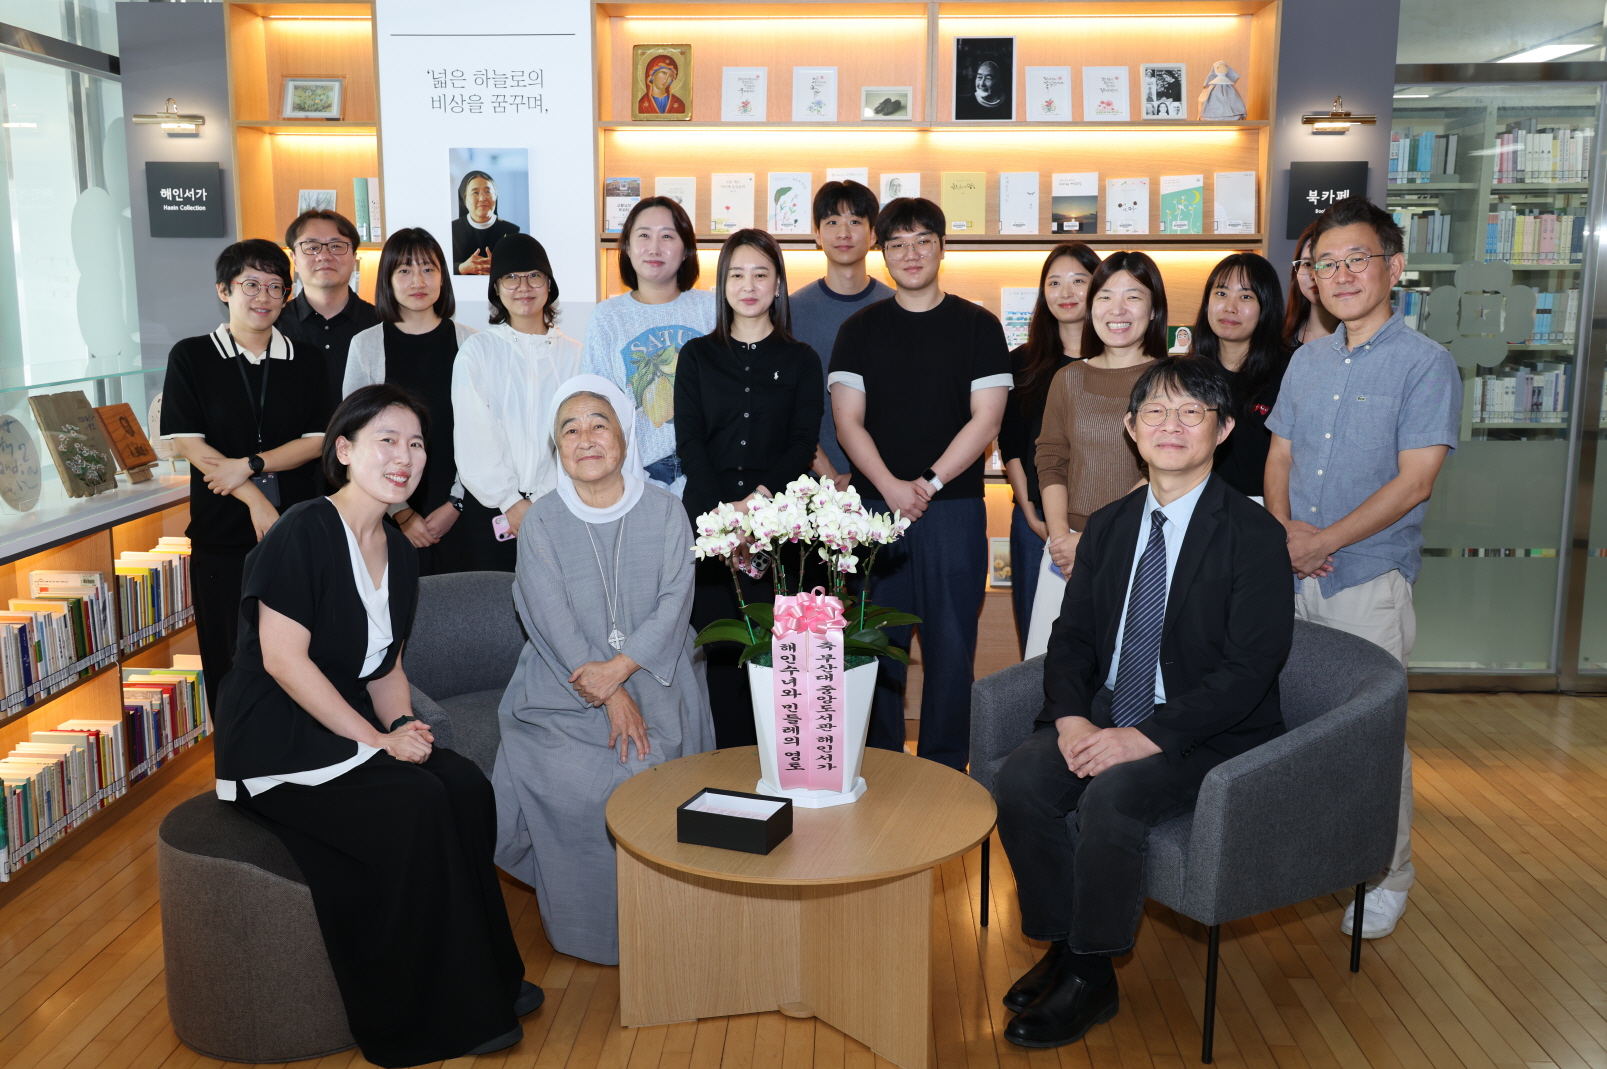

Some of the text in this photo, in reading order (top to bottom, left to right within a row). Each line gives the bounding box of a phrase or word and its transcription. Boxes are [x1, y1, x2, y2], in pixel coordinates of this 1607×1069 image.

[473, 68, 544, 88] 하늘로의
[431, 94, 549, 114] 비상을 꿈꾸며,
[159, 187, 208, 202] 해인서가
[1306, 189, 1350, 205] 북카페
[630, 329, 701, 354] SATU
[779, 642, 805, 771] 해인수녀와 민들레의 영토
[815, 640, 838, 771] 축 부산대 중앙도서관 해인서가
